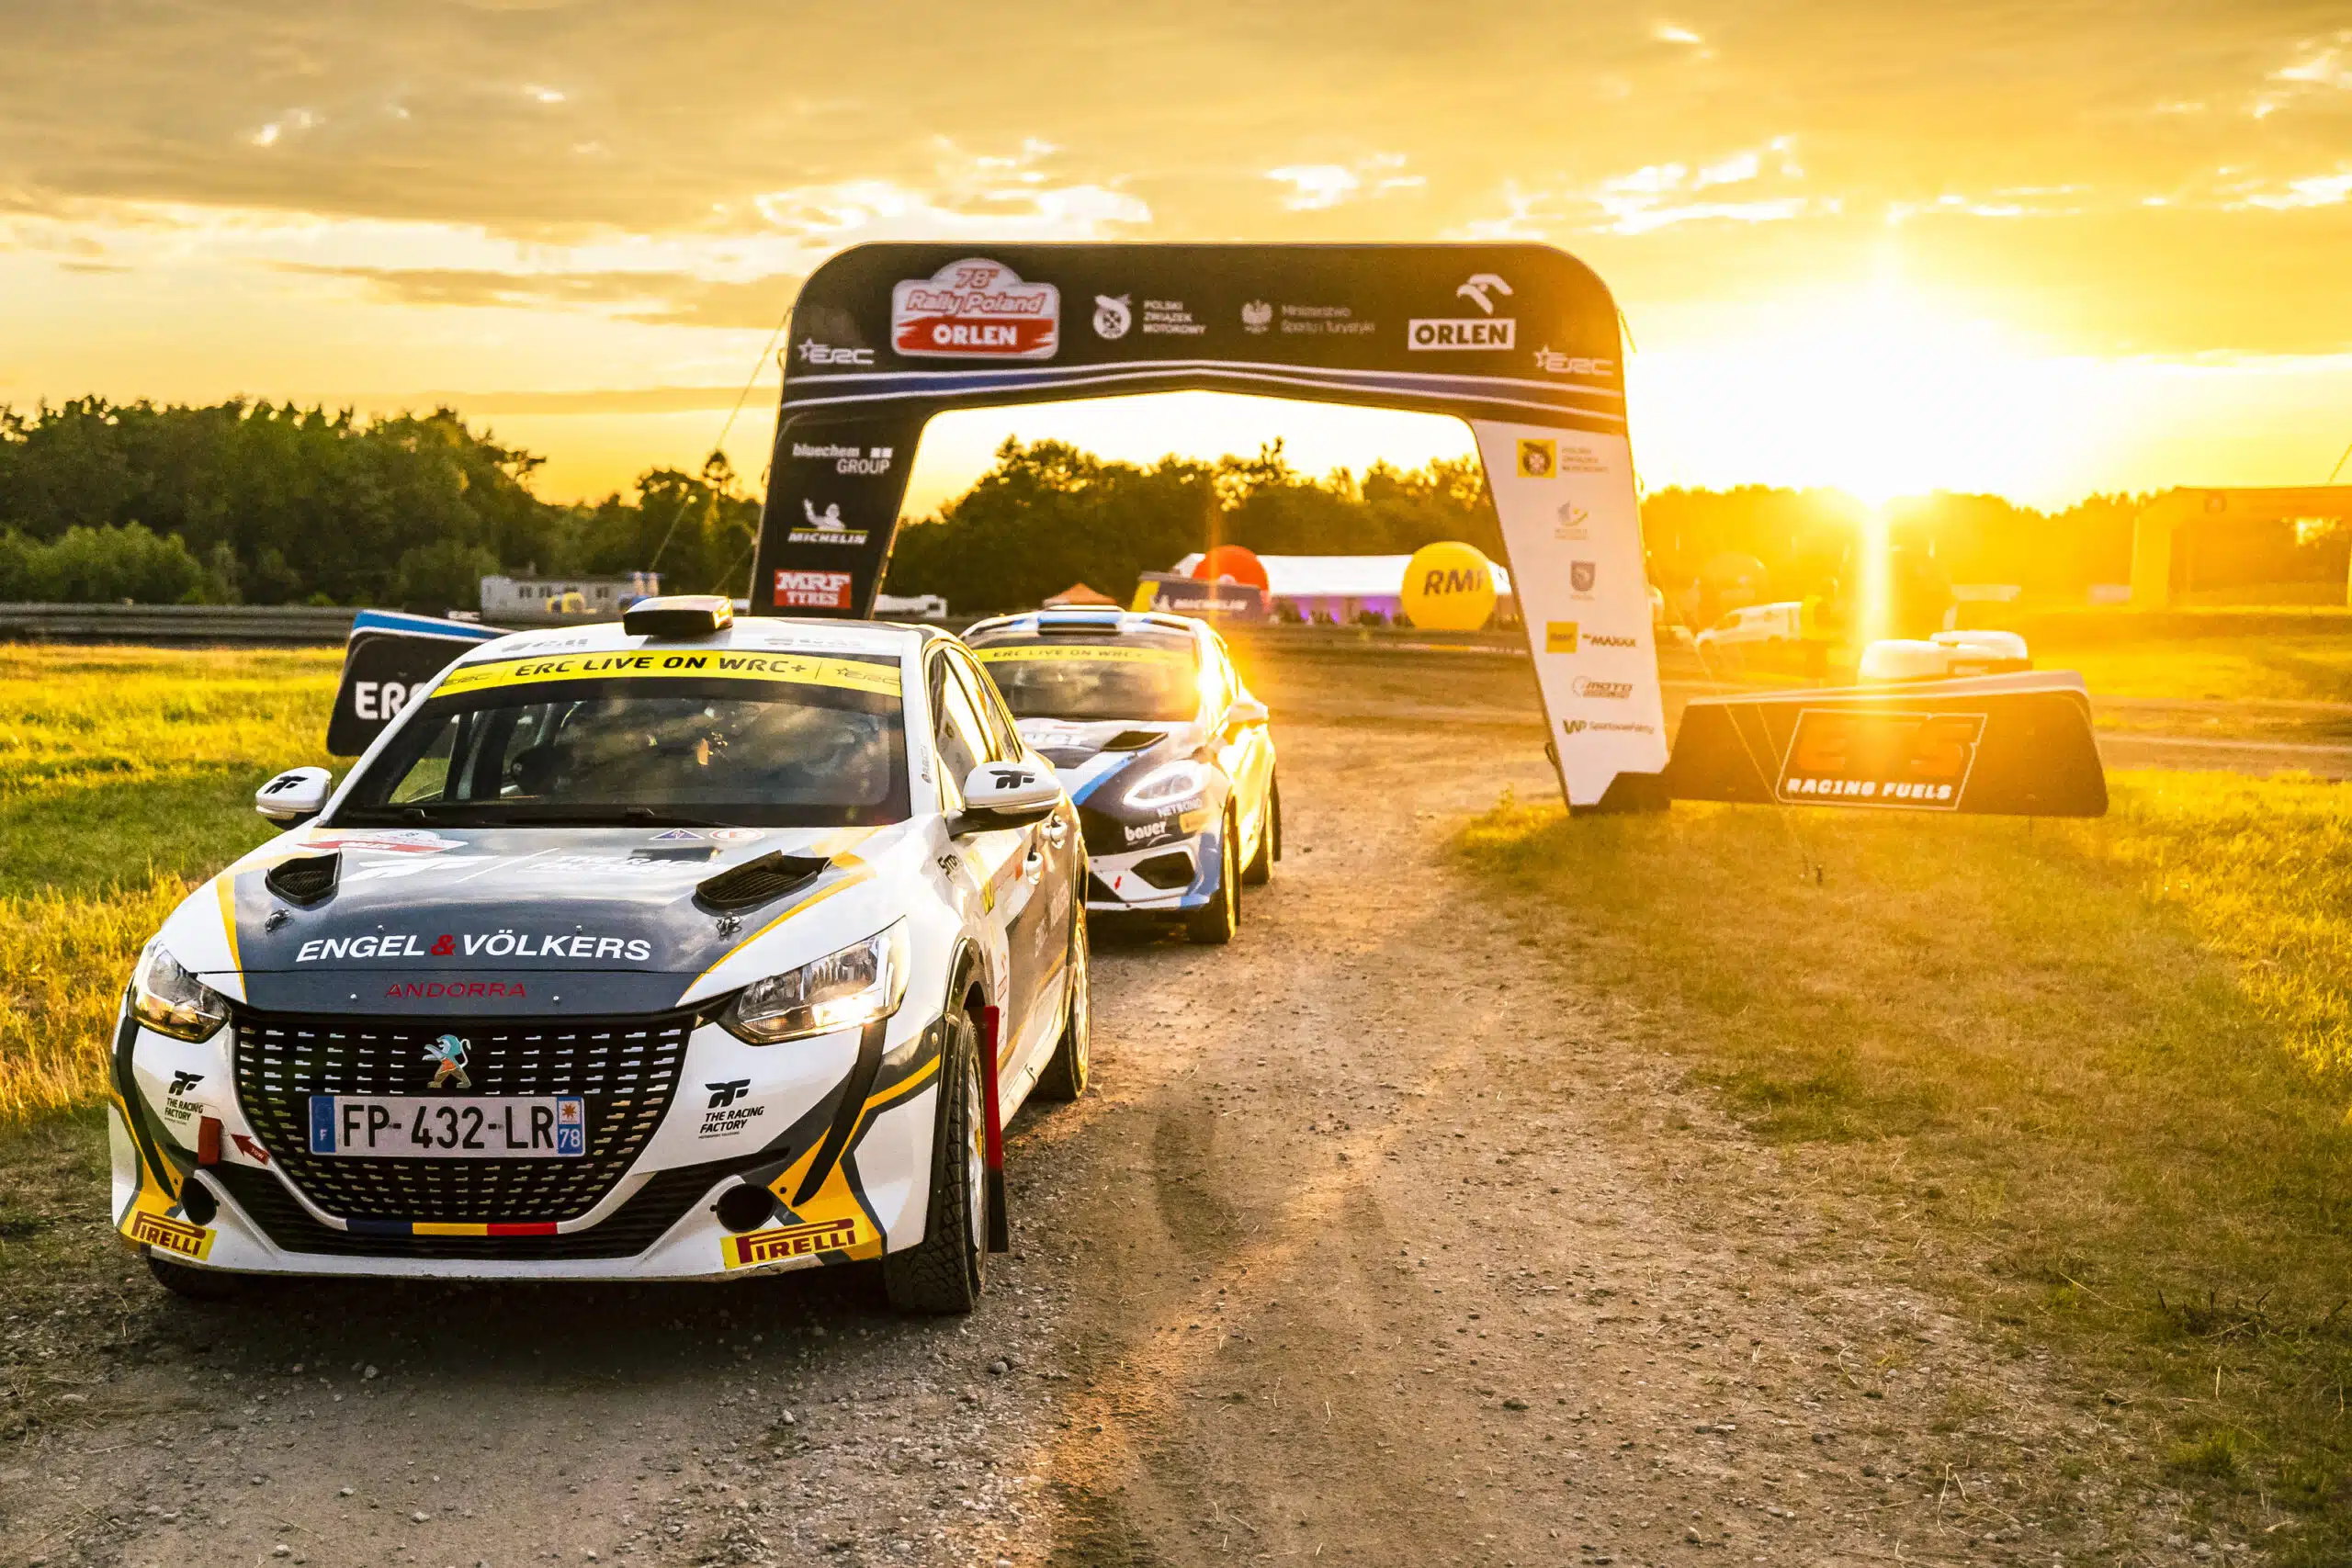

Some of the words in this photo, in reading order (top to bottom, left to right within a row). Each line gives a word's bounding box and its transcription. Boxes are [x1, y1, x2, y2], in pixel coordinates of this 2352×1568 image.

[906, 289, 963, 316] Rally
[964, 291, 1046, 314] Poland
[933, 323, 1017, 345] ORLEN
[1415, 325, 1508, 344] ORLEN
[792, 443, 860, 457] bluechem
[837, 458, 890, 474] GROUP
[788, 532, 867, 545] MICHELIN
[776, 572, 850, 592] MRF
[786, 592, 839, 606] TYRES
[515, 661, 574, 677] ERC
[583, 657, 653, 671] LIVE
[663, 657, 707, 669] ON
[719, 657, 807, 673] WRC+
[1786, 778, 1876, 797] RACING
[1883, 782, 1953, 800] FUELS
[1125, 820, 1167, 841] bauer
[296, 935, 425, 963] ENGEL
[430, 934, 456, 956] &
[463, 930, 651, 961] VÖLKERS
[385, 982, 526, 998] ANDORRA
[164, 1108, 192, 1121] FACTORY
[166, 1097, 178, 1107] THE
[178, 1100, 204, 1113] RACING
[706, 1111, 726, 1122] THE
[727, 1106, 764, 1120] RACING
[320, 1129, 327, 1140] F
[343, 1104, 554, 1149] FP-432-LR
[699, 1119, 748, 1134] FACTORY
[560, 1128, 581, 1148] 78
[131, 1211, 207, 1256] PIRELLI
[736, 1218, 856, 1264] PIRELLI
